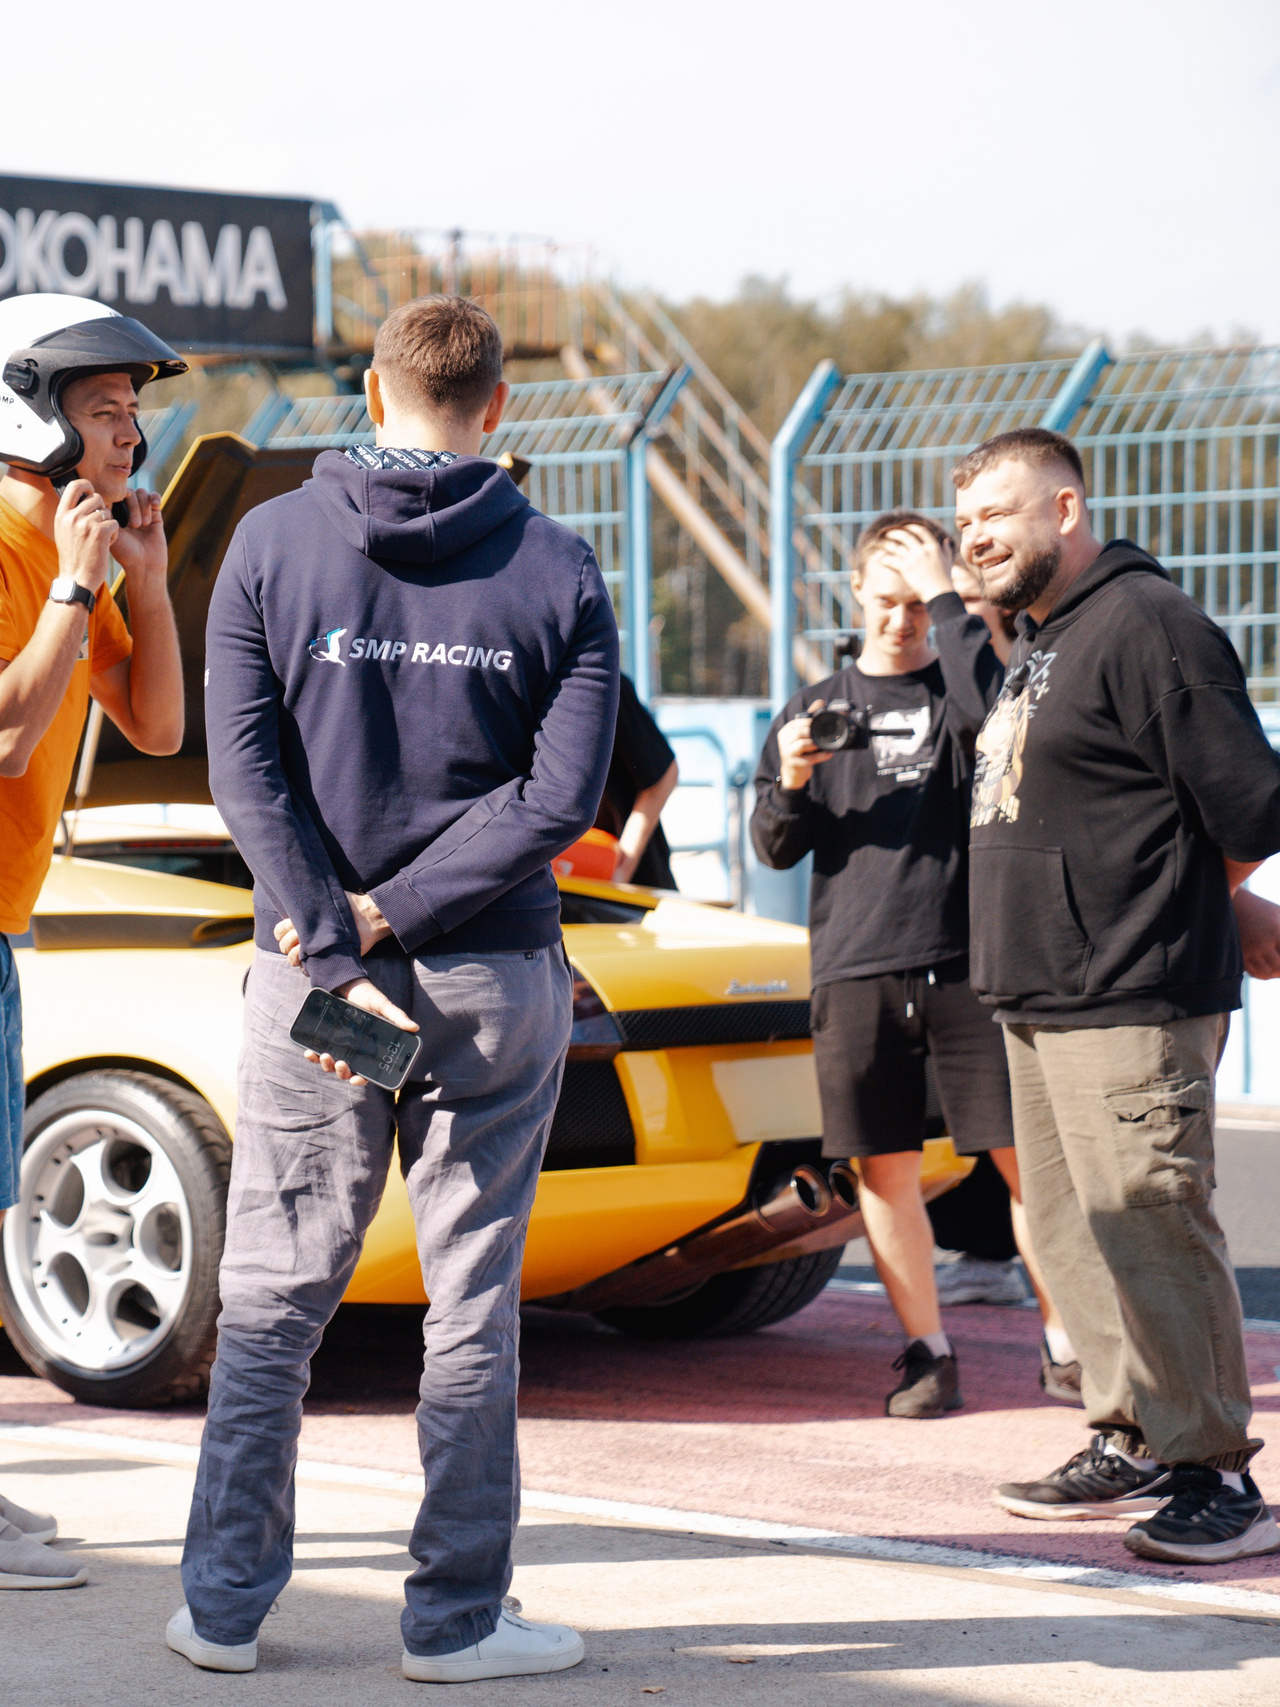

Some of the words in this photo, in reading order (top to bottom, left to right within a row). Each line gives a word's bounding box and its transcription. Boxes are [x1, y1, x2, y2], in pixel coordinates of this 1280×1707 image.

[349, 638, 408, 661] SMP
[411, 642, 513, 671] RACING
[378, 1041, 400, 1072] 13:05
